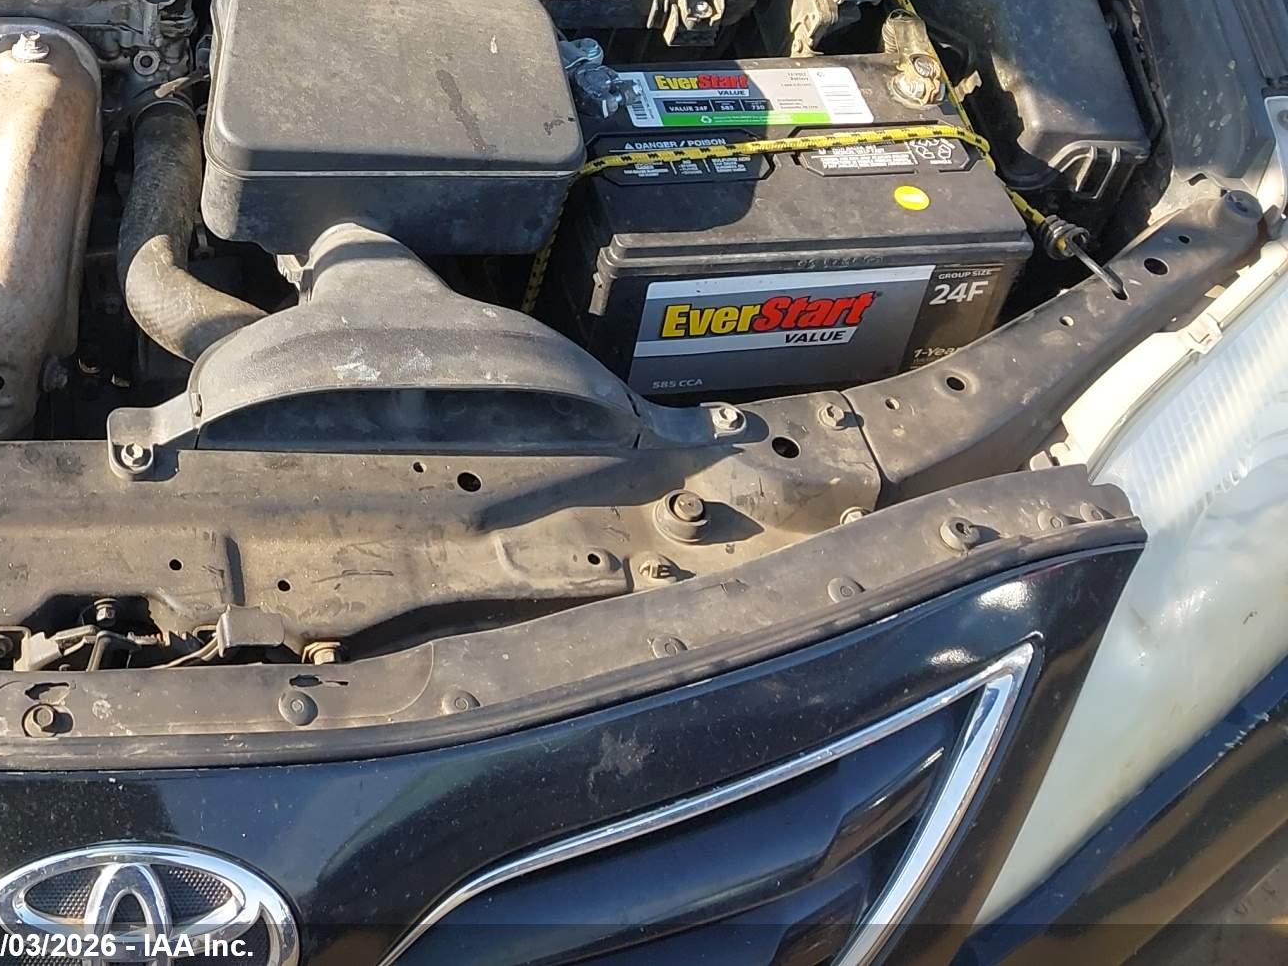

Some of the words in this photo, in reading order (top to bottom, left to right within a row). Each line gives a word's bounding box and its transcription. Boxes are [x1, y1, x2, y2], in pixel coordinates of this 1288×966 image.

[654, 74, 748, 90] EverStart
[634, 140, 677, 150] DANGER
[687, 138, 726, 147] POISON
[938, 271, 972, 280] GROUP
[972, 269, 993, 277] SIZE
[928, 280, 989, 306] 24F
[661, 289, 877, 338] EverStart
[784, 330, 847, 344] VALUE
[913, 346, 958, 358] 1-Yea
[678, 378, 703, 387] CCA
